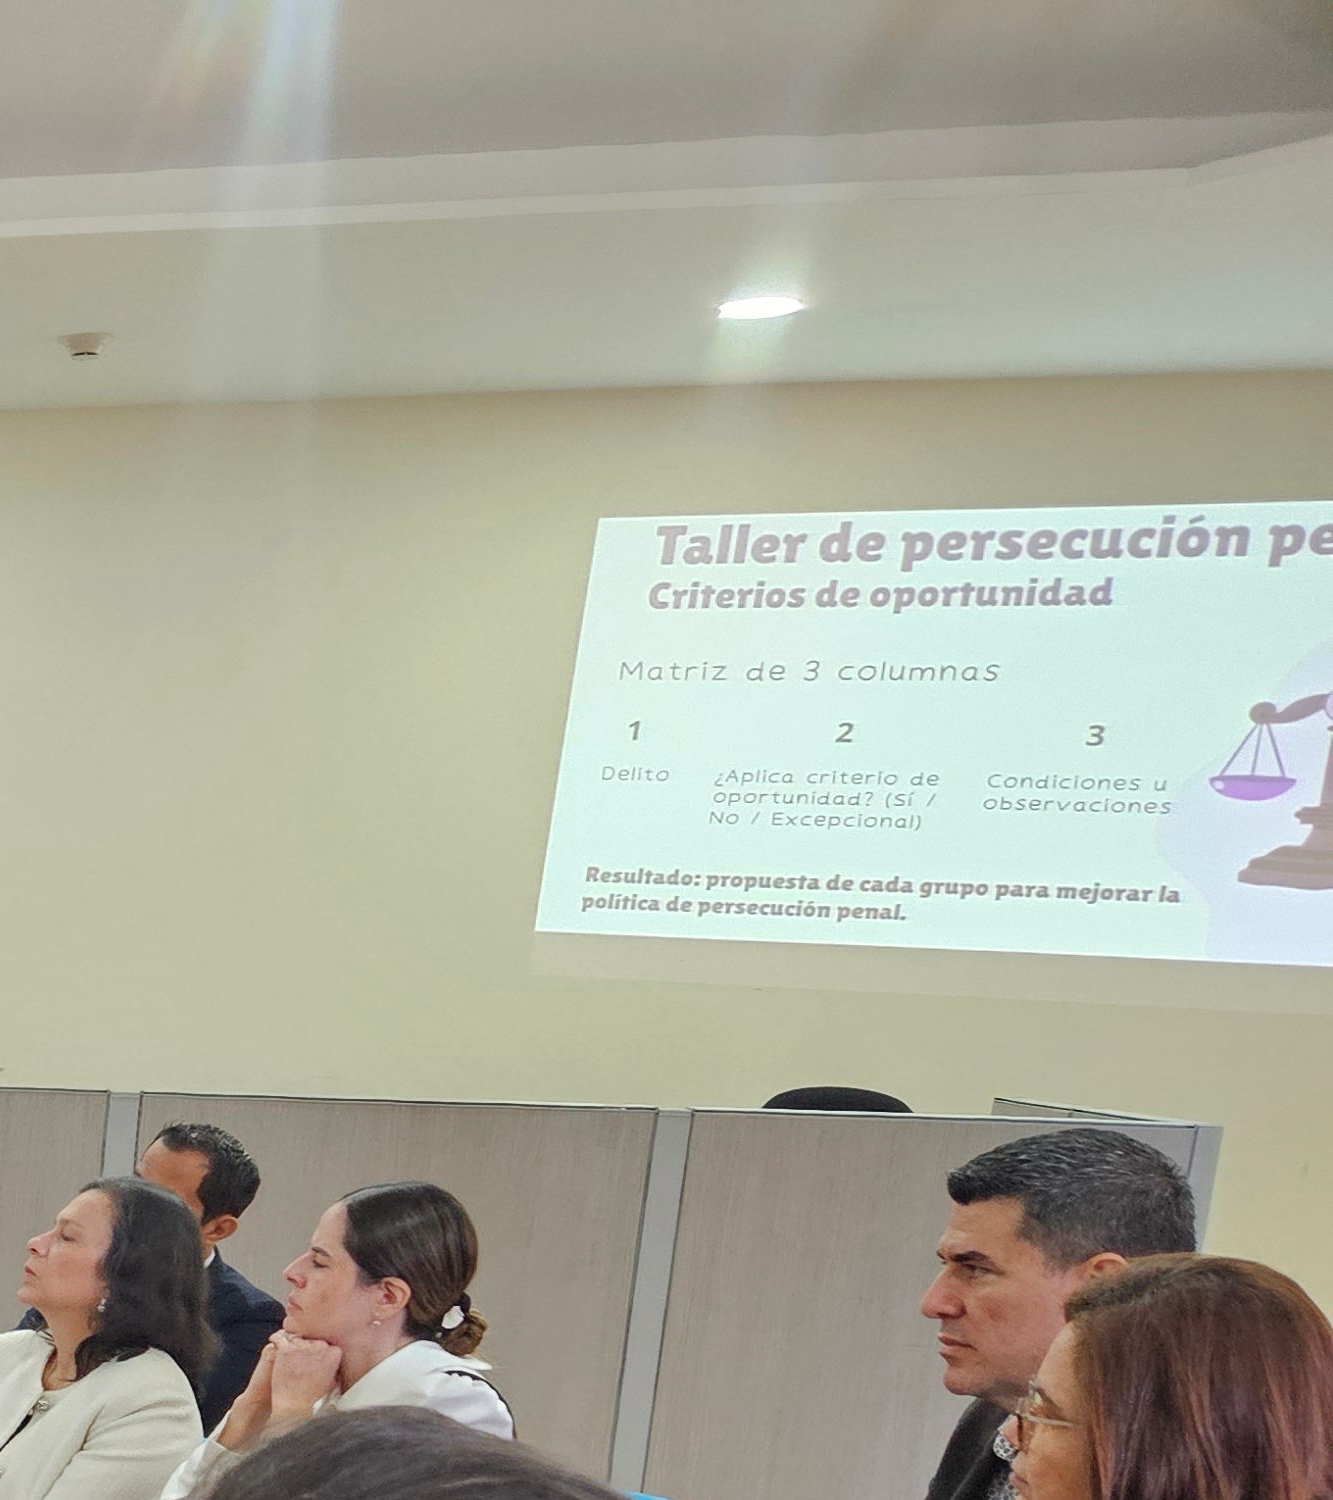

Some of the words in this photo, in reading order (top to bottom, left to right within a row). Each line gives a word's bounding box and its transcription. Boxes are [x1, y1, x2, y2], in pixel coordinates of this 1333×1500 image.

[656, 523, 809, 566] Taller
[818, 520, 887, 564] de
[900, 514, 1251, 573] persecución
[648, 580, 807, 610] Criterios
[815, 579, 861, 609] de
[869, 576, 1114, 615] oportunidad
[619, 660, 728, 681] Matriz
[746, 661, 786, 682] de
[803, 660, 820, 682] 3
[837, 661, 1001, 682] columnas
[628, 720, 641, 741] 1
[835, 722, 854, 744] 2
[1085, 724, 1106, 747] 3
[601, 765, 670, 782] Delito
[713, 769, 794, 788] ¿Aplica
[806, 770, 899, 786] criterio
[909, 772, 940, 787] de
[987, 773, 1142, 792] Condiciones
[713, 791, 874, 807] oportunidad?
[885, 791, 916, 809] (Sí
[925, 793, 937, 807] /
[982, 796, 1172, 815] observaciones
[708, 811, 740, 825] No
[750, 811, 761, 826] /
[771, 811, 922, 832] Excepcional)
[585, 866, 702, 887] Resultado:
[705, 874, 821, 893] propuesta
[825, 873, 855, 892] de
[859, 875, 914, 894] cada
[919, 881, 989, 900] grupo
[994, 883, 1050, 901] para
[1056, 882, 1154, 905] mejorar
[1158, 884, 1181, 904] la
[581, 893, 661, 913] política
[665, 895, 693, 913] de
[697, 899, 831, 918] persecución
[836, 903, 907, 923] penal.
